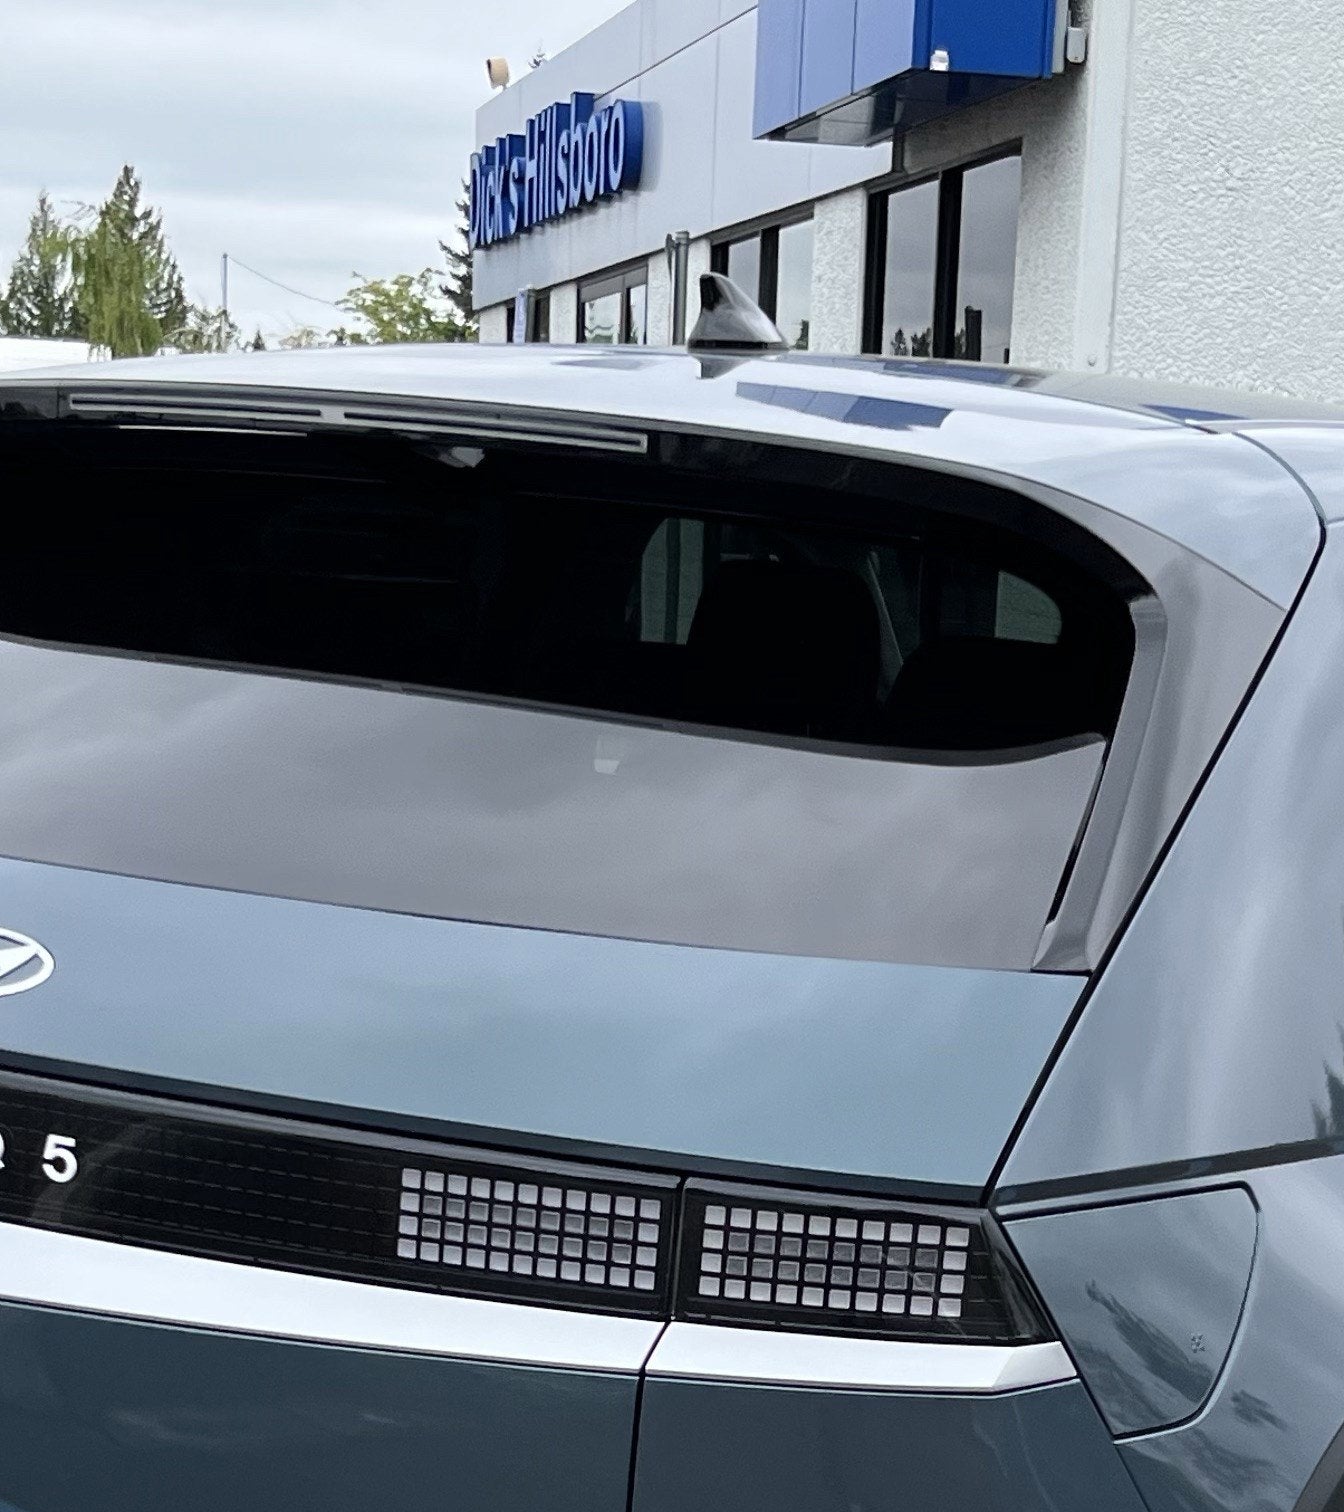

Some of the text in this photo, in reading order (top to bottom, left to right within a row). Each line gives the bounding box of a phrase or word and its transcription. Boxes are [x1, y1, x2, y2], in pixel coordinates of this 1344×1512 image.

[469, 91, 630, 250] Dick's Hillsboro
[42, 1133, 78, 1183] 5
